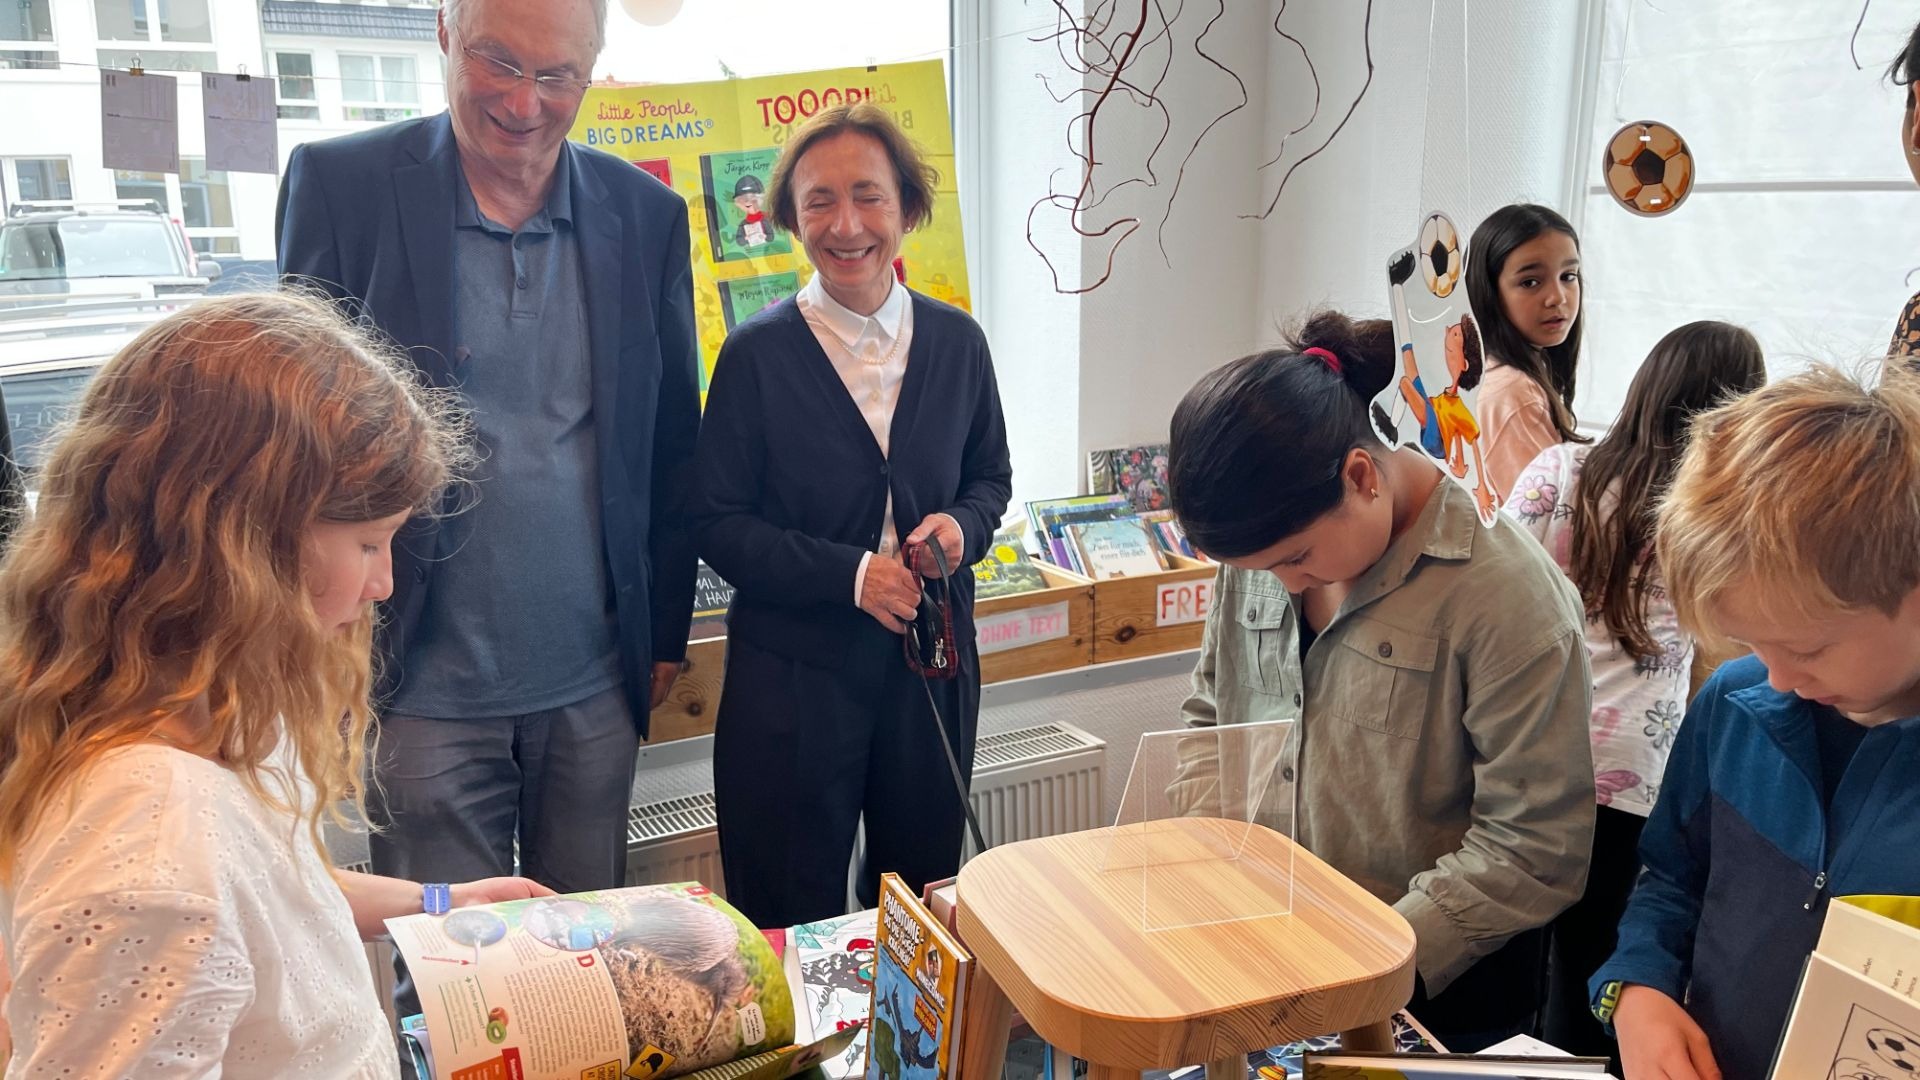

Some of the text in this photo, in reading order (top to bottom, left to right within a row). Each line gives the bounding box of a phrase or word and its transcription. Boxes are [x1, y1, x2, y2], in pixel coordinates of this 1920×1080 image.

[597, 98, 698, 123] Little People,
[587, 127, 617, 145] BIG
[980, 611, 1064, 646] OHNE TEXT
